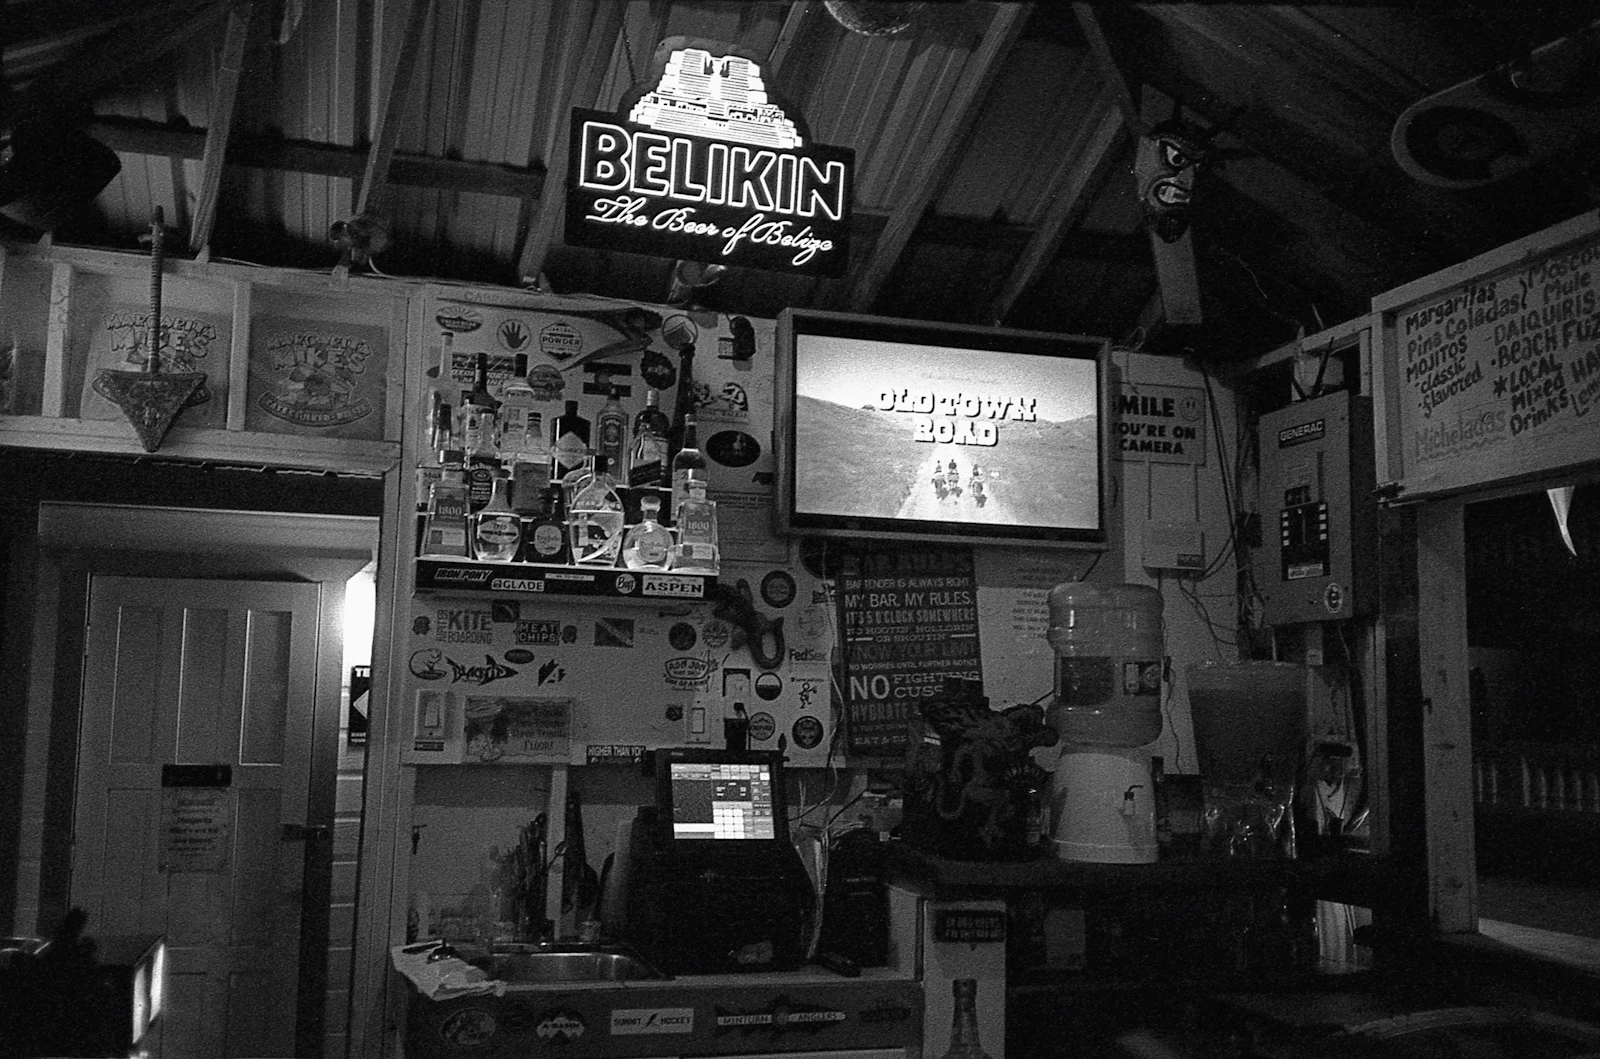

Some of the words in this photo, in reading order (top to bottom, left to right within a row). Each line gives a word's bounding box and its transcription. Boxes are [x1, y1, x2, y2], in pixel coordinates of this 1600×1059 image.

[580, 121, 845, 220] BELIKIN
[585, 196, 648, 228] The
[652, 207, 720, 236] Beer
[722, 214, 764, 255] of
[751, 221, 833, 265] Belize
[1544, 271, 1591, 304] Mule
[1406, 282, 1497, 336] Margaritas
[1445, 294, 1519, 341] Coladas
[541, 336, 581, 346] POWDER
[1406, 334, 1467, 384] MOJITOS
[912, 414, 1000, 447] ROAD
[1172, 425, 1196, 440] ON
[1280, 420, 1323, 441] GENERAC
[1118, 438, 1185, 455] CAMERA
[438, 505, 462, 516] 1800
[687, 521, 710, 531] 1800
[436, 569, 460, 580] IRON
[461, 570, 490, 581] PONY
[908, 577, 944, 588] ALWAYS
[645, 582, 702, 593] ASPEN
[905, 592, 925, 607] MY
[916, 607, 976, 623] SOMEWHERE
[519, 623, 556, 633] MEAT
[519, 632, 557, 643] CHIPS
[875, 635, 891, 643] OR
[850, 673, 890, 700] NO
